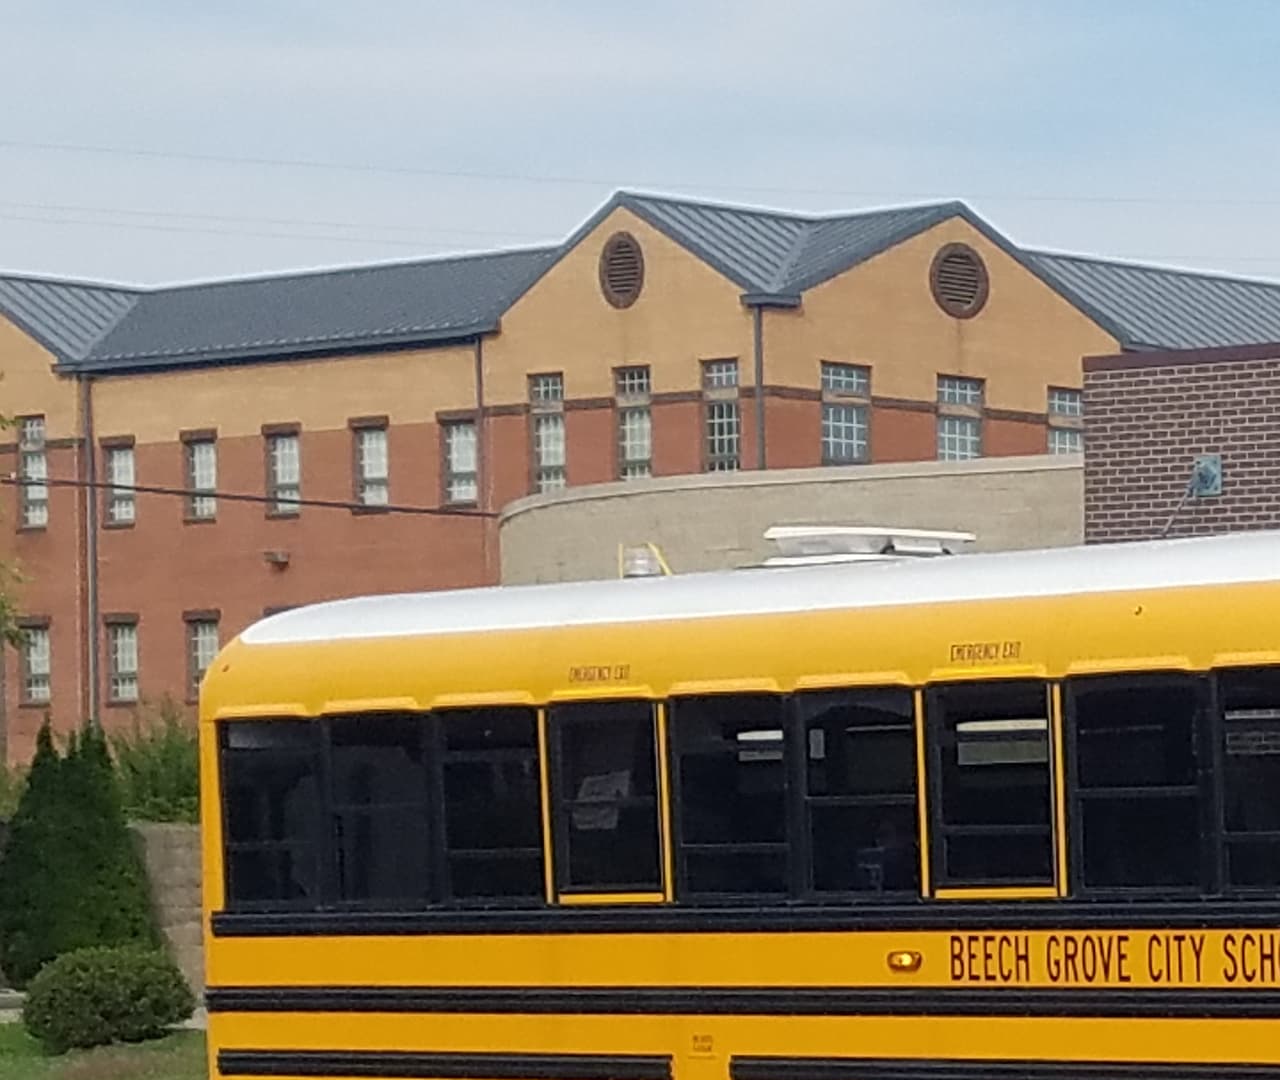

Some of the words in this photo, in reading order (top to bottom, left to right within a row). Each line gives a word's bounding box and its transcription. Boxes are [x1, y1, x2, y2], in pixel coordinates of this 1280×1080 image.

[950, 935, 1030, 982] BEECH
[1046, 935, 1131, 982] GROVE
[1148, 934, 1205, 983] CITY
